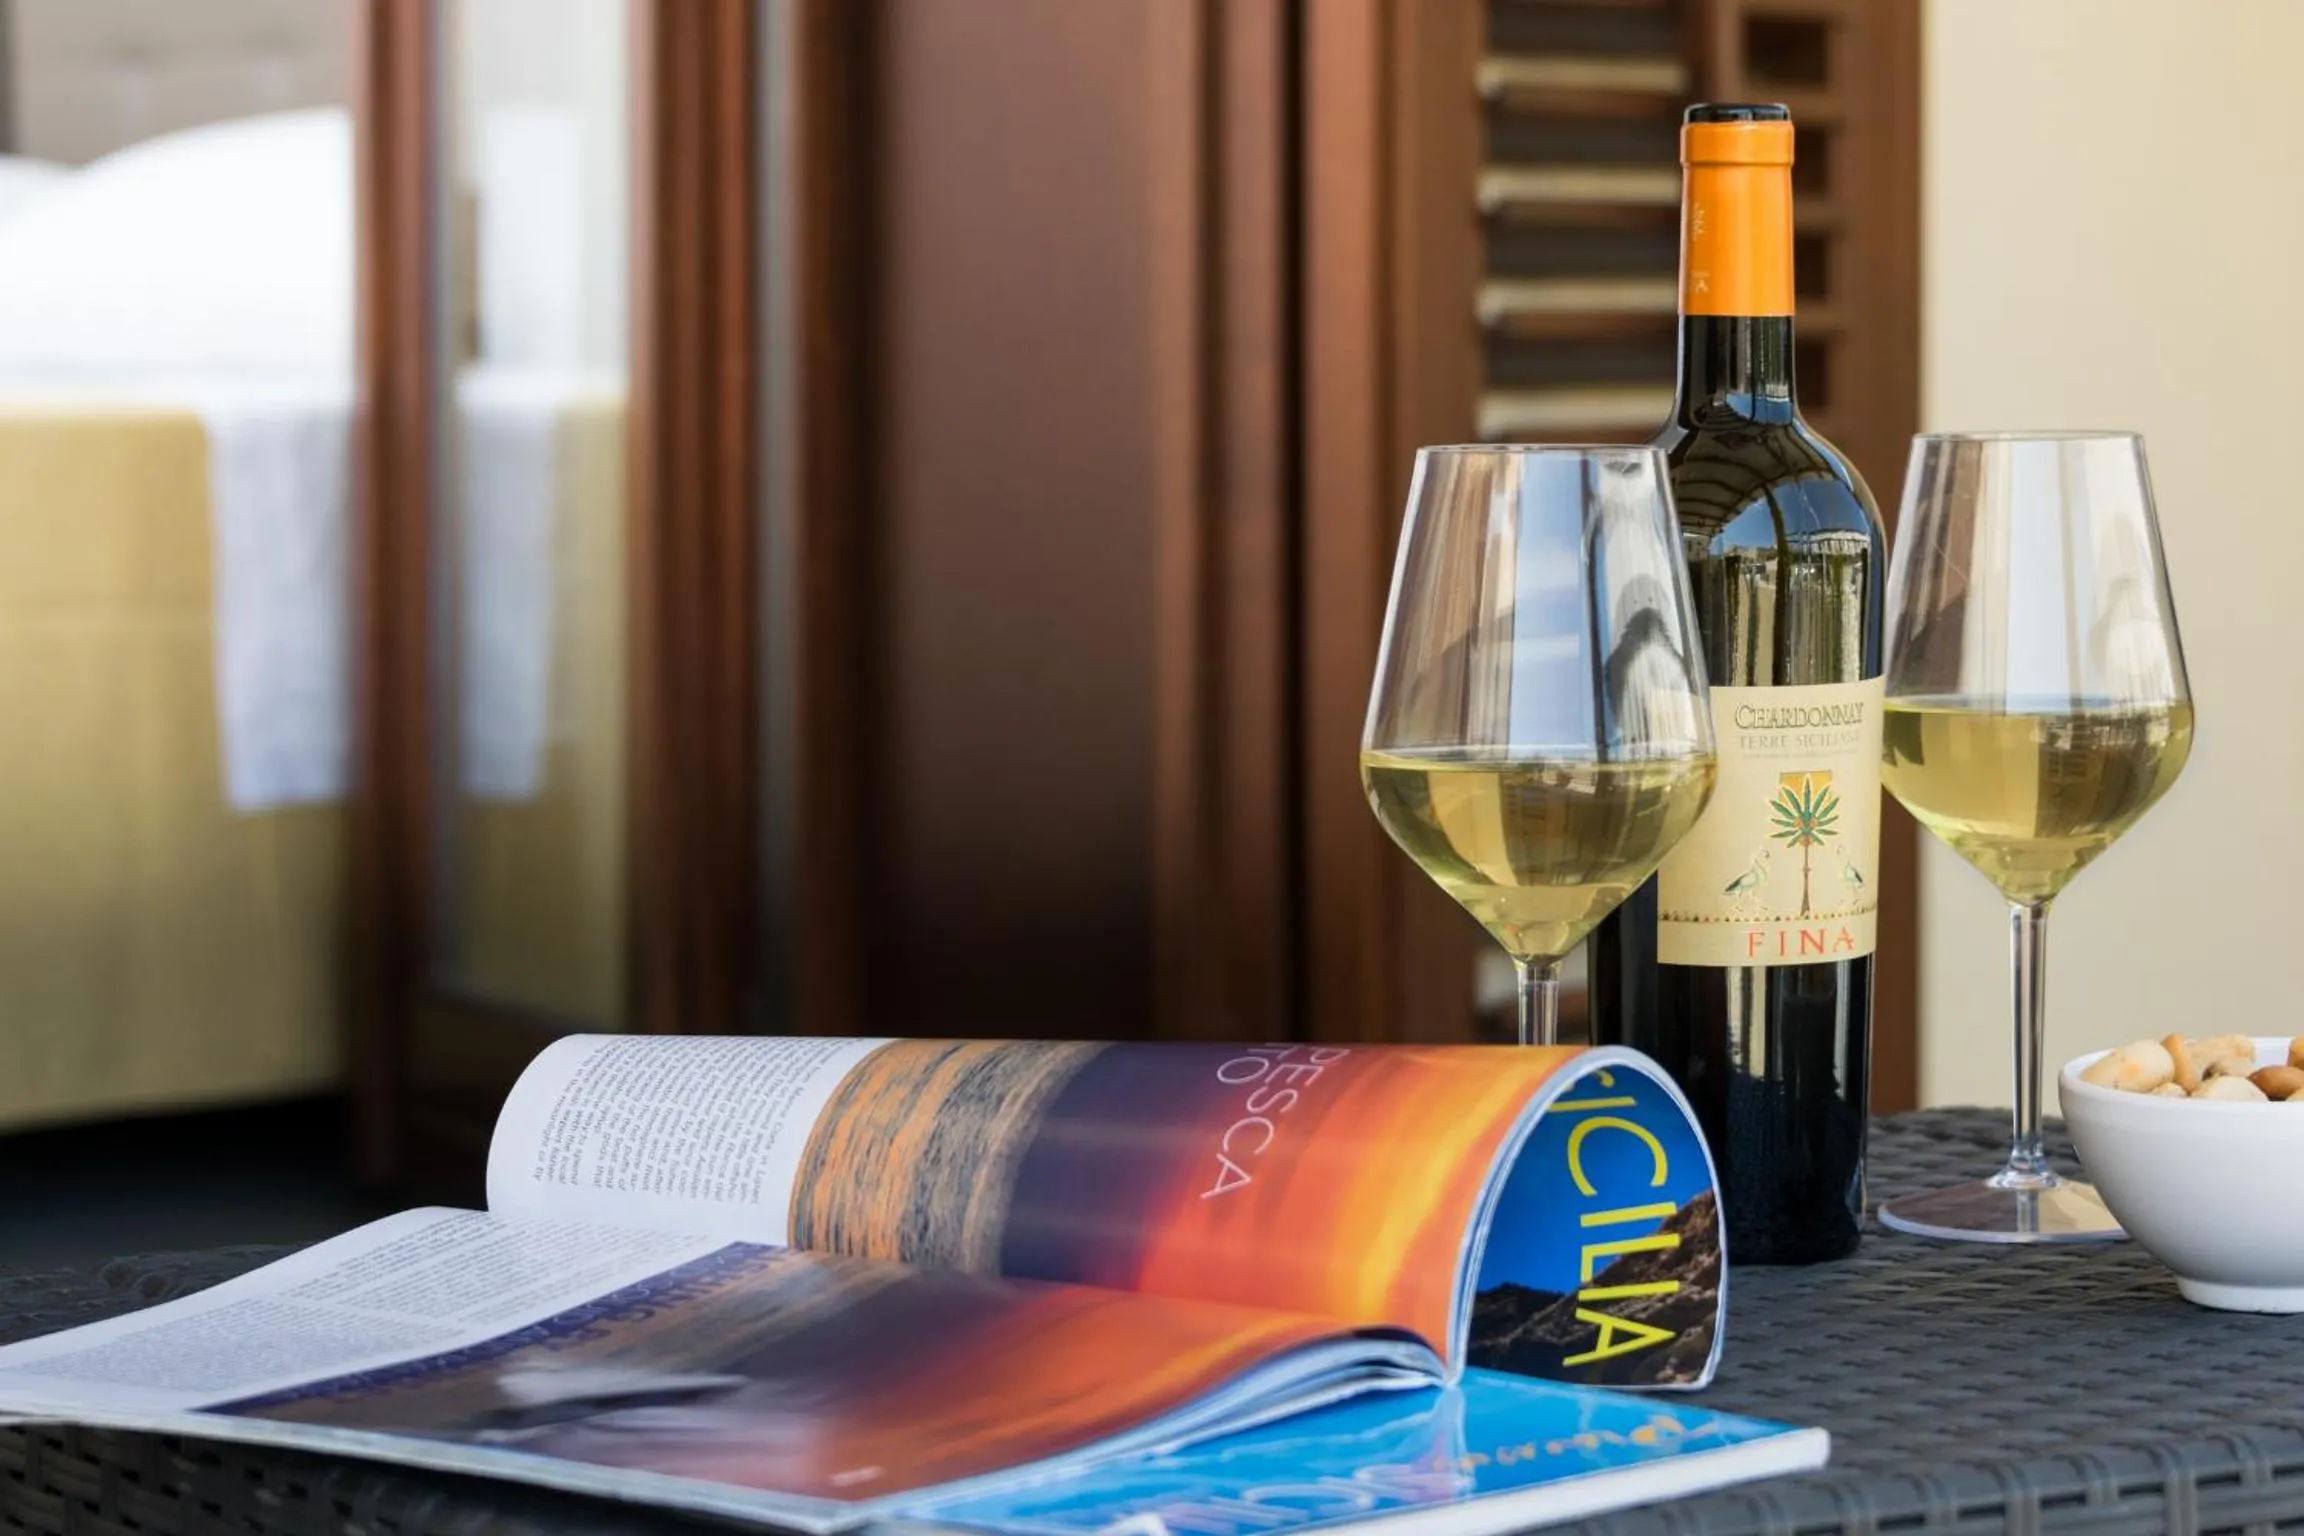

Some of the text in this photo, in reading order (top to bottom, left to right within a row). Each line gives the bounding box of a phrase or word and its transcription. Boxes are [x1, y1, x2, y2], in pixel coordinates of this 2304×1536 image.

[1735, 702, 1864, 730] CHARDONNAY
[1739, 734, 1788, 750] TERRE
[1746, 926, 1855, 959] FINA
[1202, 1047, 1352, 1199] PESCA
